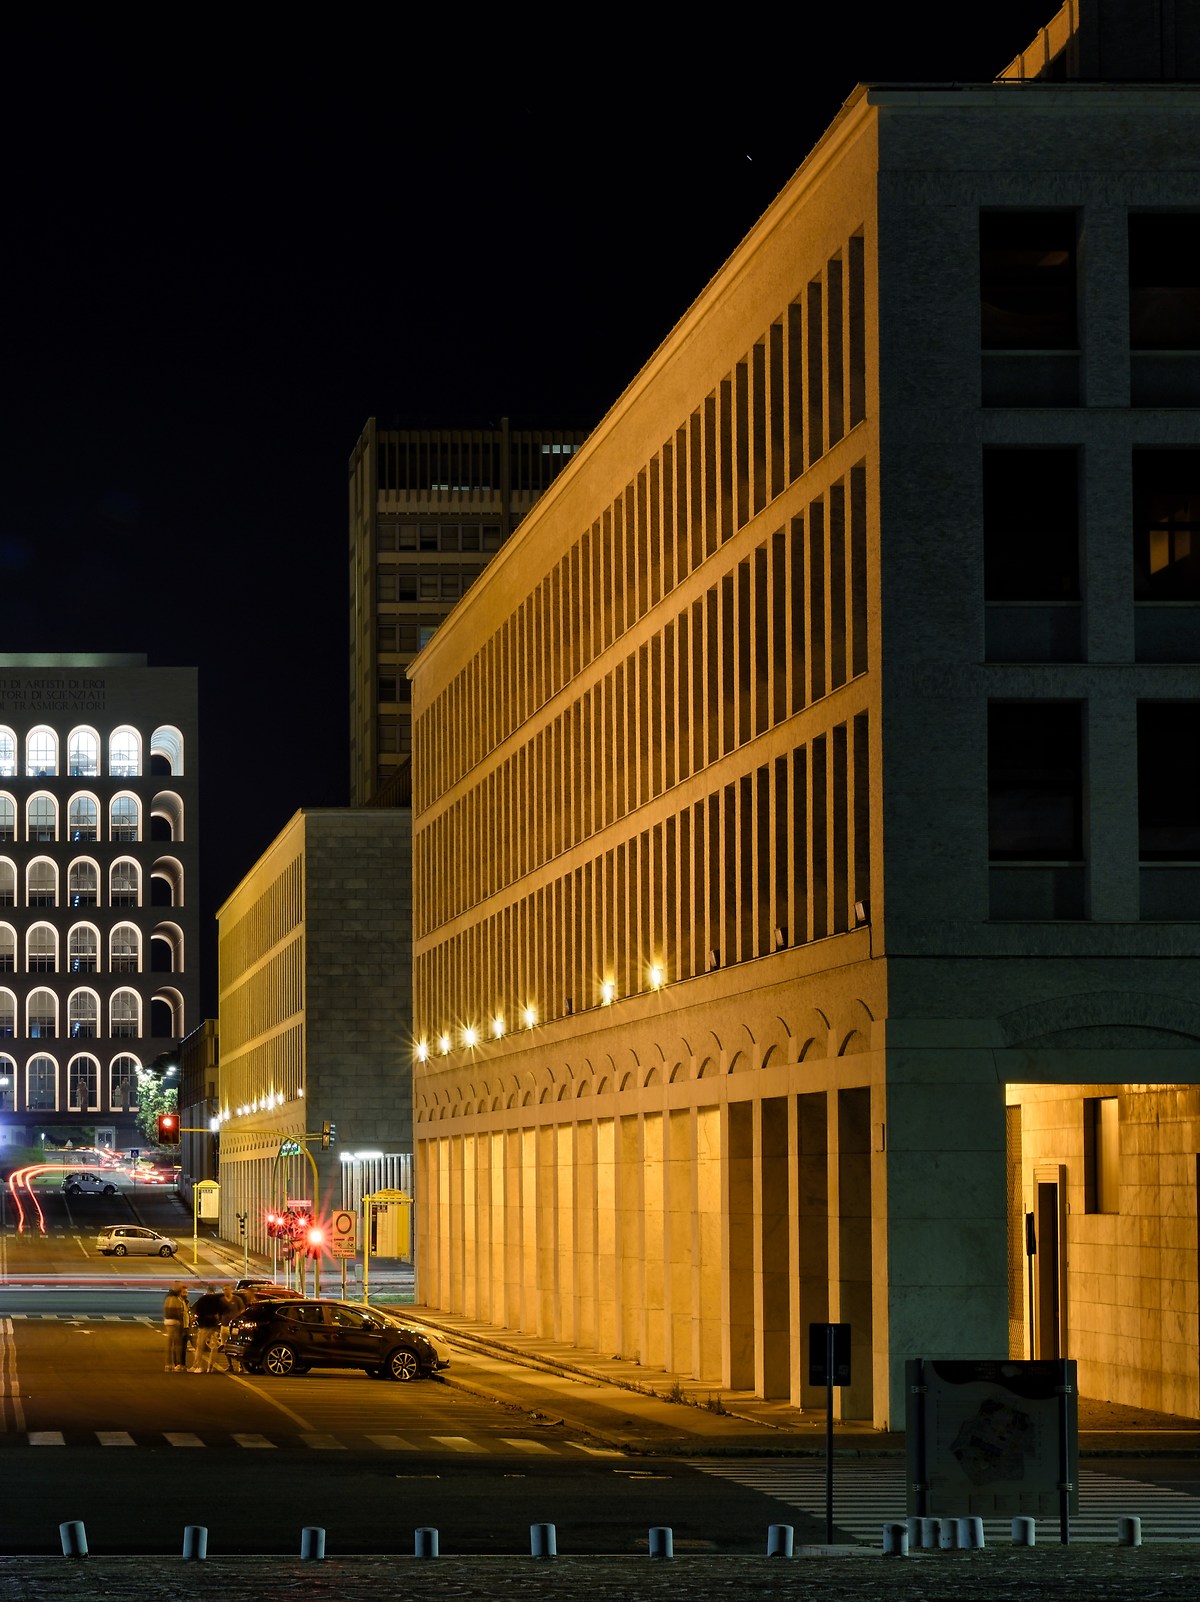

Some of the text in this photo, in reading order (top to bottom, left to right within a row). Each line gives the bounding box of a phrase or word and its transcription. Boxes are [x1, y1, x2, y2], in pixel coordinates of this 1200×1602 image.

[10, 680, 21, 689] DI
[25, 680, 65, 689] ARTISTI
[69, 680, 79, 689] DI
[83, 680, 105, 689] EROI
[32, 691, 42, 700] DI
[46, 691, 105, 700] SCIENZIATI
[14, 701, 105, 711] TRASMIGRATORI
